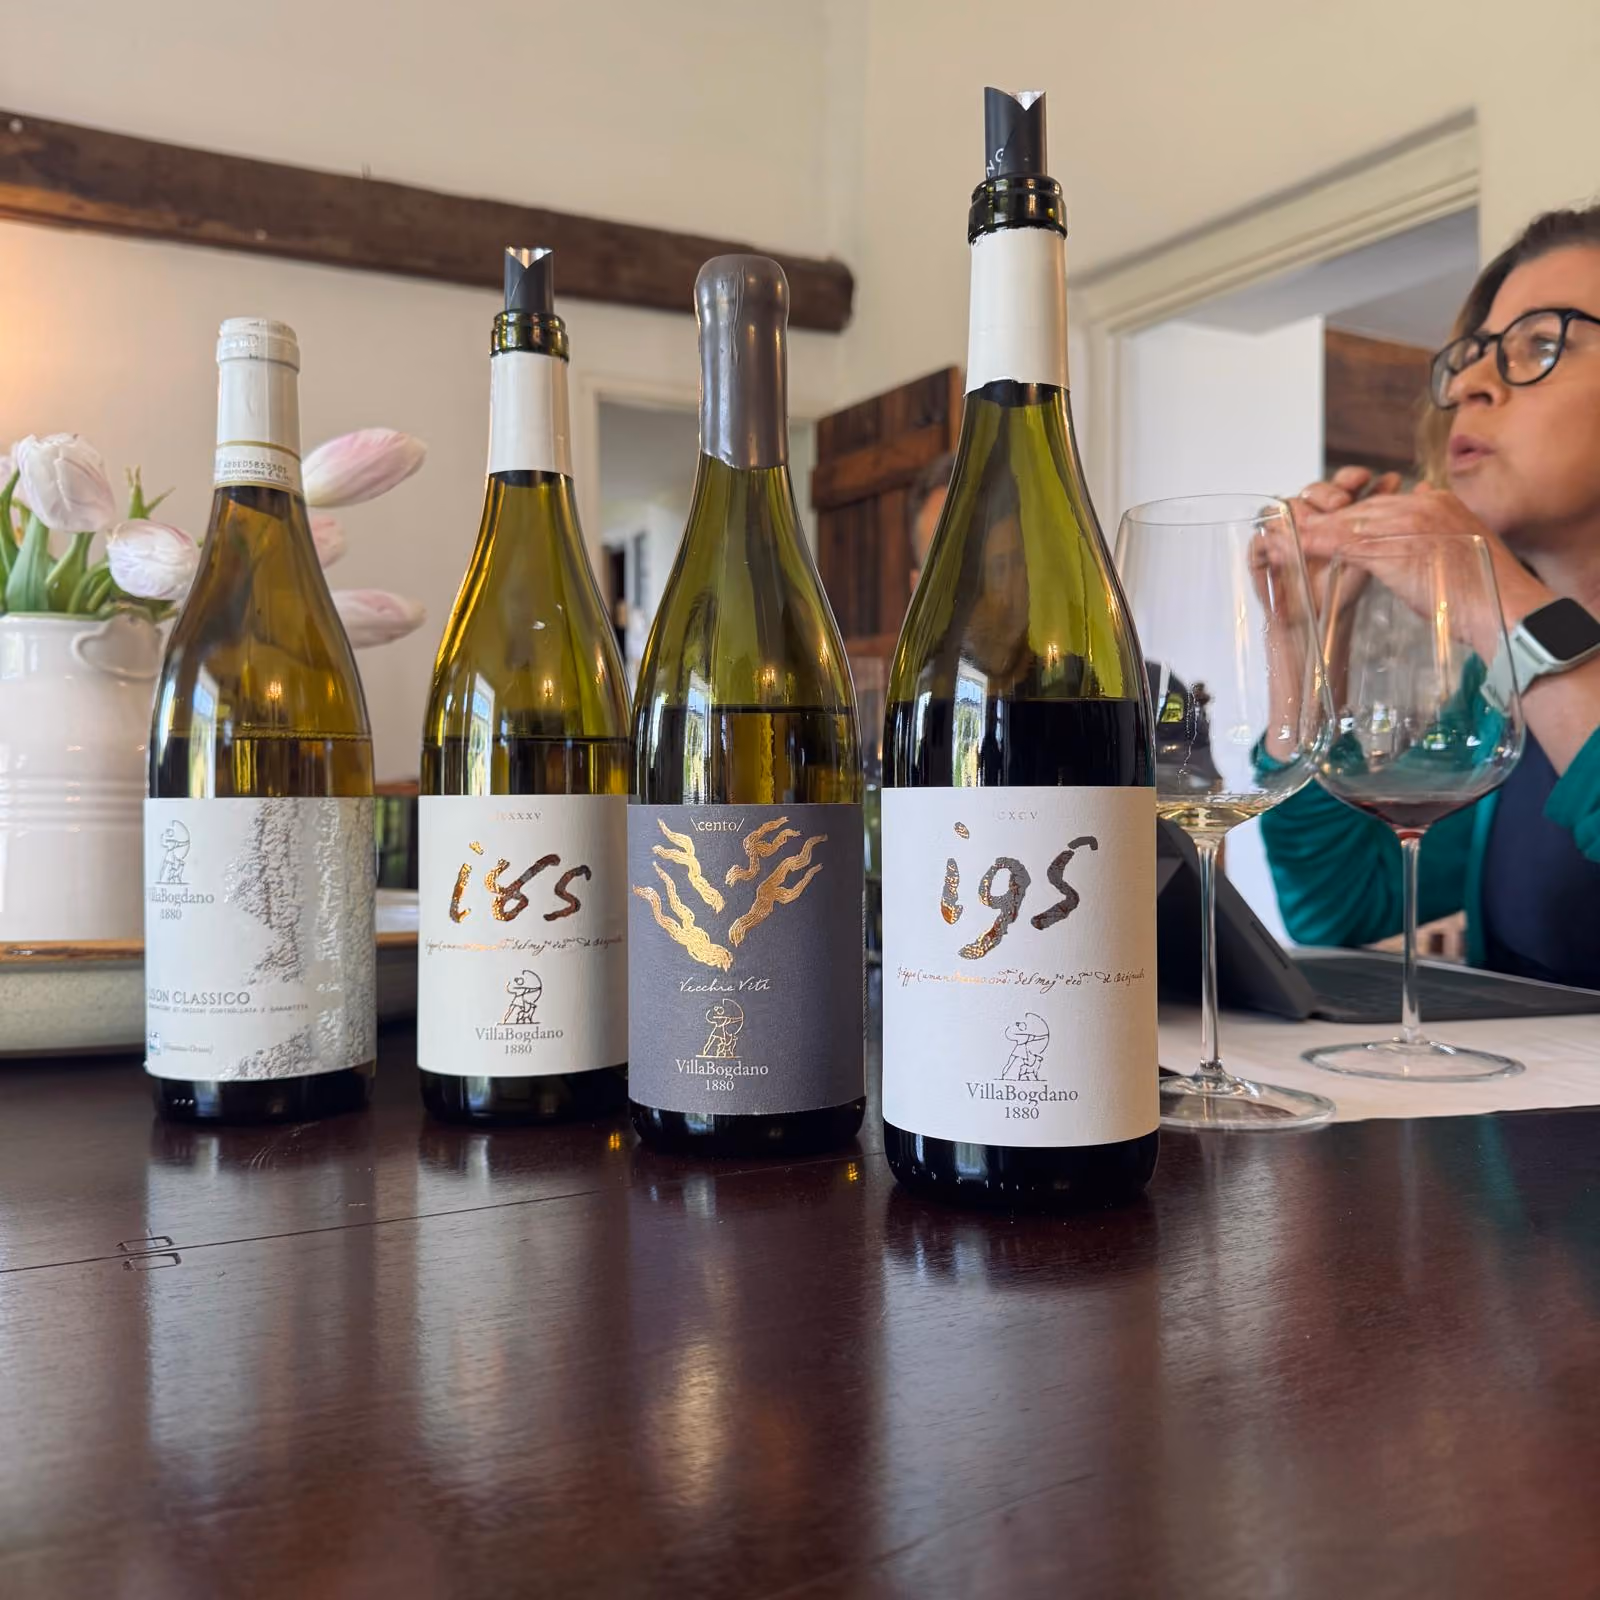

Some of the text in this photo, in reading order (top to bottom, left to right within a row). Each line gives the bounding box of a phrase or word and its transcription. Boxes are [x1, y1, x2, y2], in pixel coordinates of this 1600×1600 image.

[160, 908, 183, 920] 1880
[173, 991, 250, 1006] CLASSICO
[475, 1026, 564, 1044] VillaBogdano
[505, 1044, 532, 1055] 1880
[675, 1059, 769, 1080] VillaBogdano
[705, 1079, 735, 1091] 1880
[966, 1082, 1079, 1107] VillaBogdano
[1005, 1106, 1040, 1119] 1880
